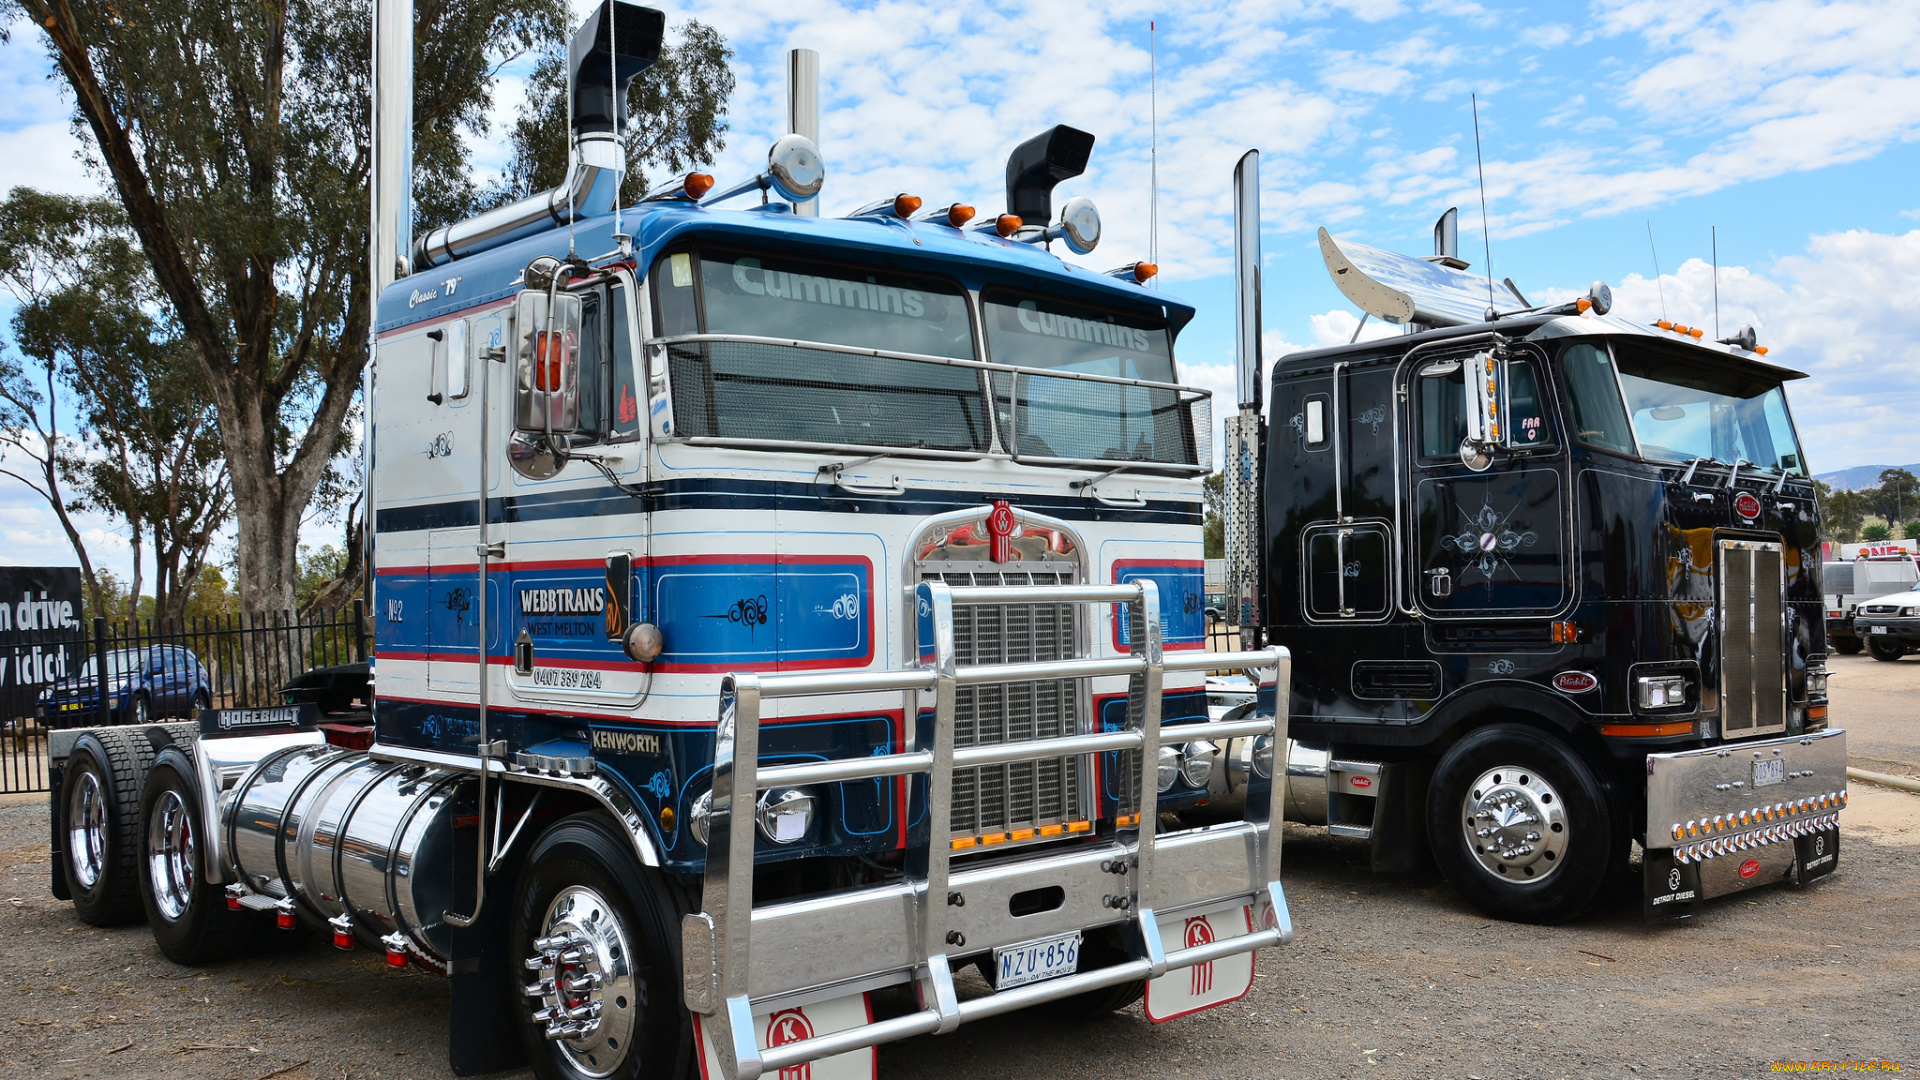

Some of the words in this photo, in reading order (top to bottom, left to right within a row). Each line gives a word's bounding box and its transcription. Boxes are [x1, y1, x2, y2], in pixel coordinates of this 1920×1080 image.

[408, 288, 438, 309] Classic
[733, 257, 925, 317] Cummins
[1017, 300, 1150, 351] Cummins
[1522, 416, 1540, 429] FAR
[17, 591, 80, 632] drive,
[520, 587, 604, 616] WEBBTRANS
[527, 622, 553, 636] WEST
[555, 622, 595, 636] MELTON
[533, 668, 559, 686] 0407
[561, 669, 579, 687] 339
[580, 671, 602, 689] 284
[218, 706, 300, 729] HOGEBUILT
[592, 730, 660, 753] KENWORTH
[1652, 893, 1675, 905] DETROIT
[1675, 890, 1695, 901] DIESEL
[1002, 948, 1037, 979] NZU
[1046, 940, 1076, 968] 856
[1041, 970, 1054, 979] THE
[1055, 966, 1073, 976] MOVE
